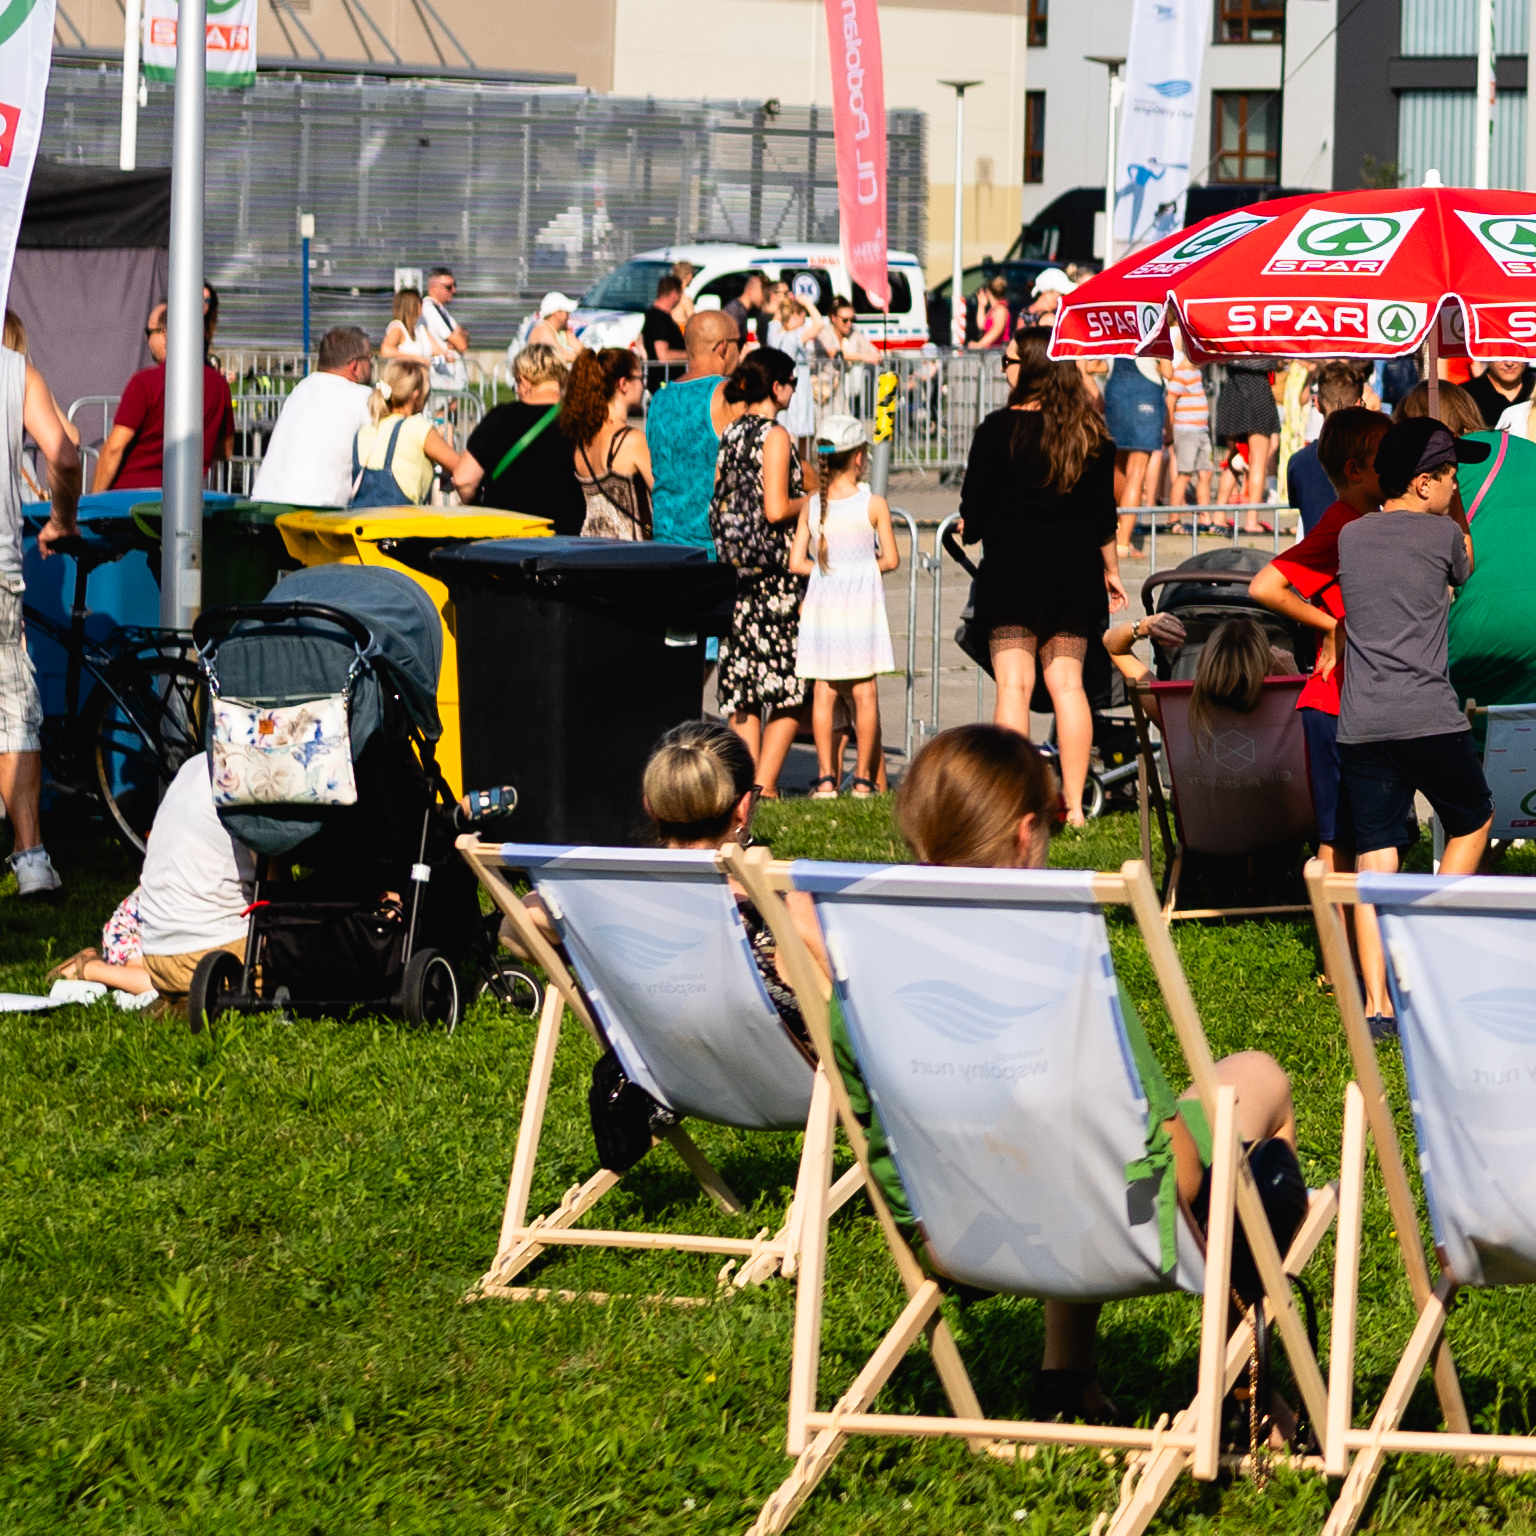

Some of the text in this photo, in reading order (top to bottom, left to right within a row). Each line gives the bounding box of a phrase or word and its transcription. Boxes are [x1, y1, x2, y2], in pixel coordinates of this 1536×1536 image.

[153, 21, 248, 50] SAR
[1271, 260, 1382, 273] SPAR
[1086, 310, 1137, 339] SPAR
[1226, 304, 1366, 334] SPAR
